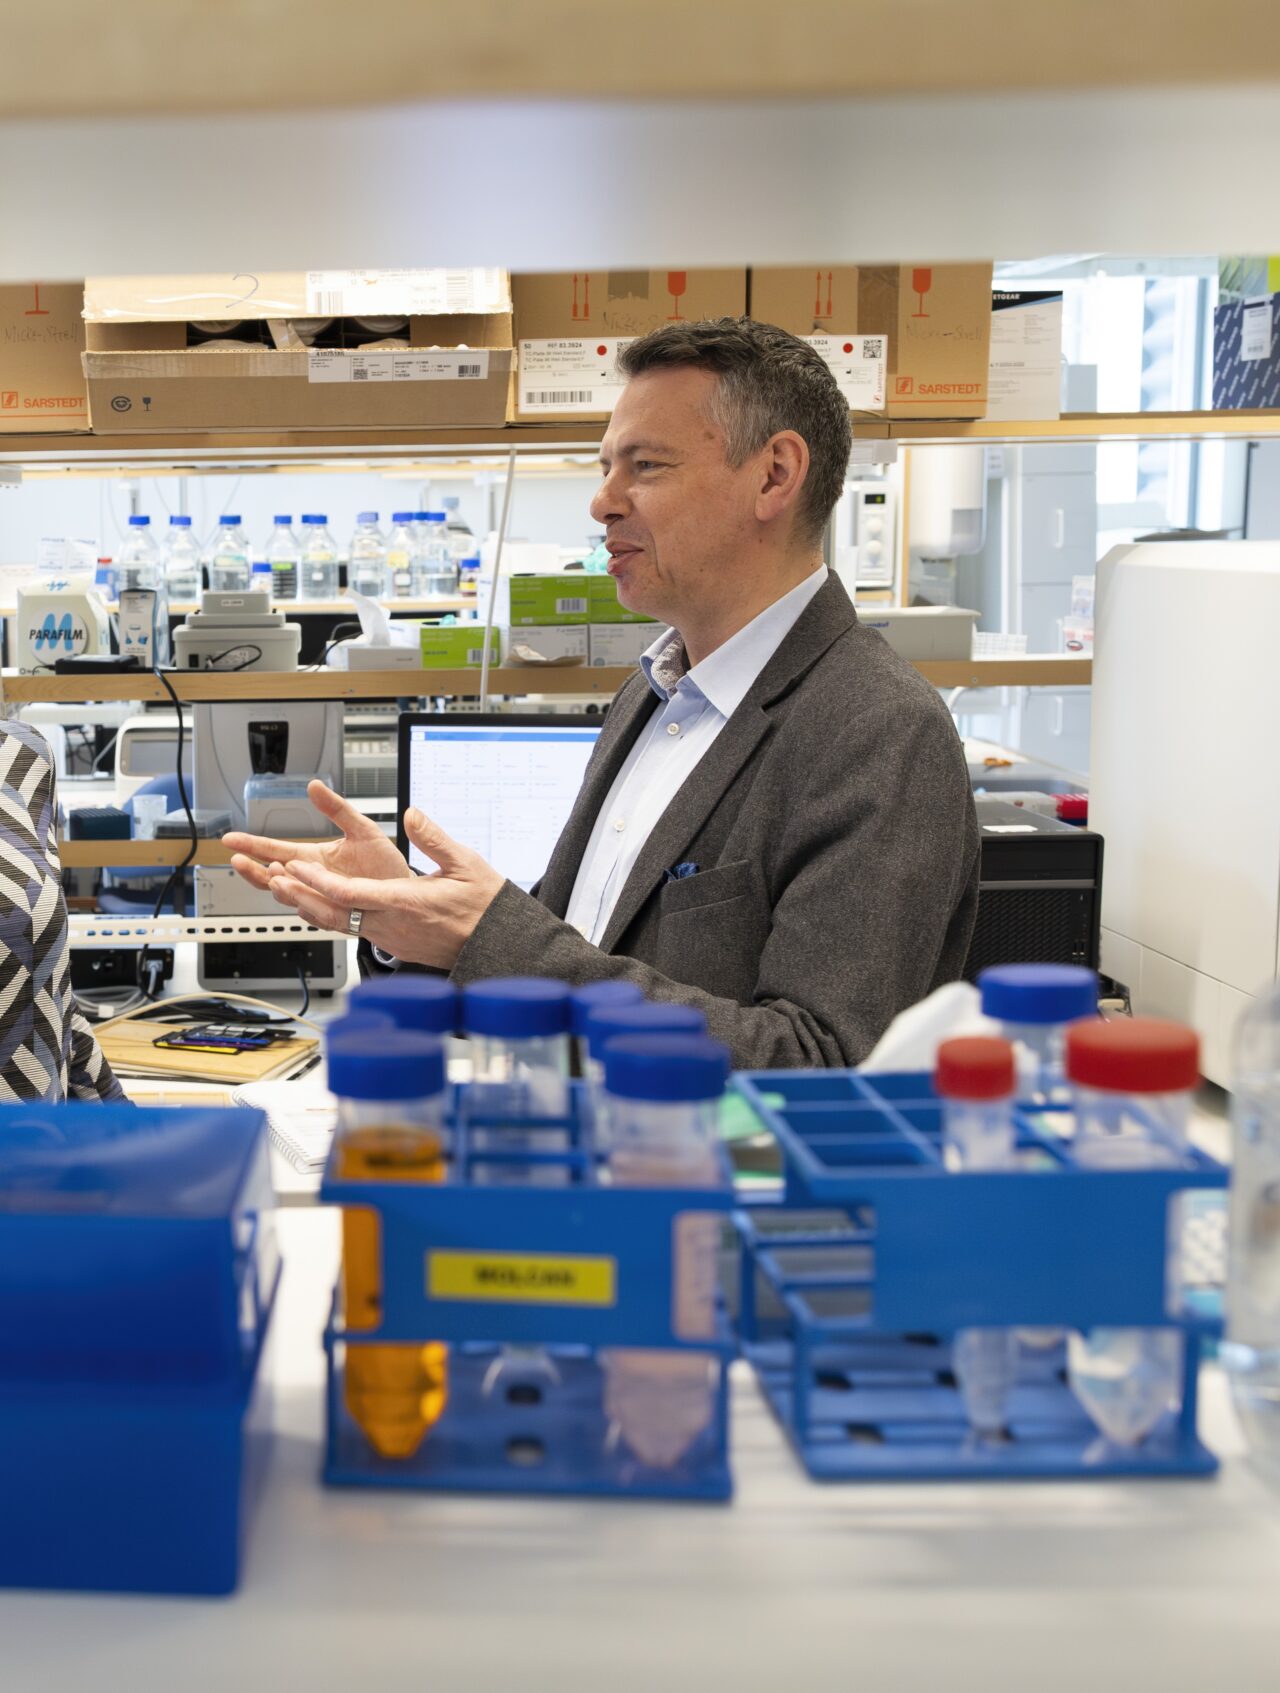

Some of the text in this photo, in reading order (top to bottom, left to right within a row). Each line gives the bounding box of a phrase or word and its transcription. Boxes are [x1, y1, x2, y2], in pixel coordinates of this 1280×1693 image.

[918, 383, 982, 394] SARSTEDT
[23, 397, 86, 408] SARSTEDT
[29, 629, 83, 640] PARAFILM
